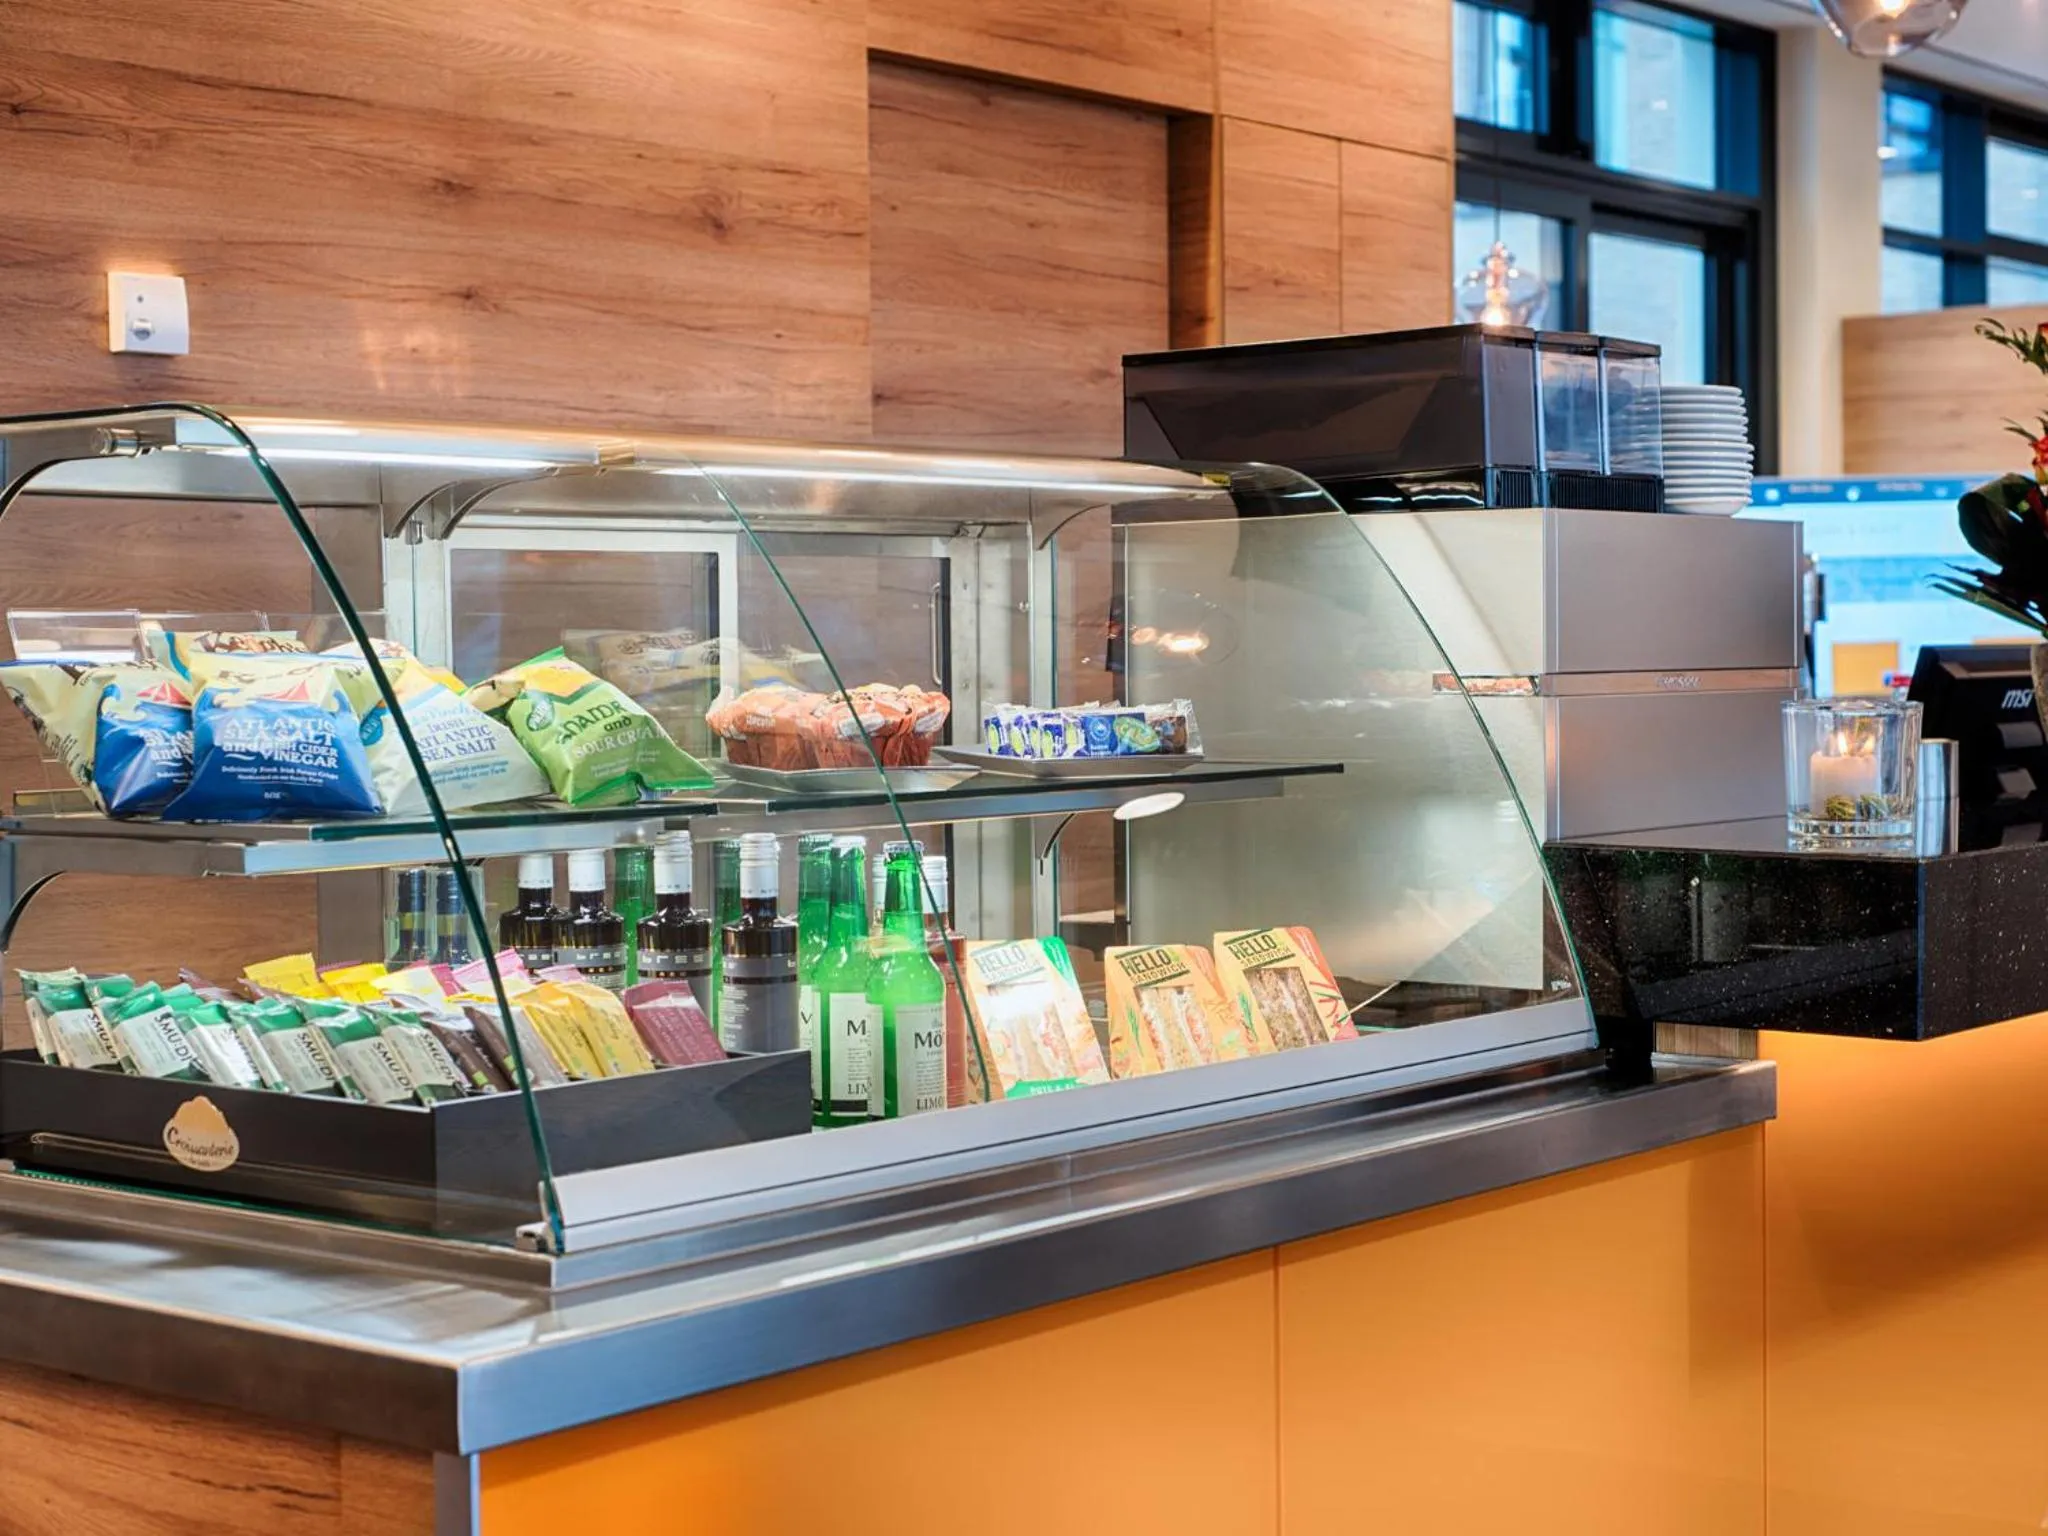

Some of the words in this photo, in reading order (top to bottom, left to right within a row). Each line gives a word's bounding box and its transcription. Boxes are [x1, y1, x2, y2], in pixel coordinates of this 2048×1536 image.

[222, 718, 336, 735] ATLANTIC
[603, 715, 632, 732] and
[223, 727, 271, 741] SEA
[275, 727, 336, 746] SALT
[222, 739, 259, 753] and
[298, 742, 339, 758] CIDER
[456, 737, 498, 757] SALT
[260, 747, 339, 768] VINEGAR
[1227, 934, 1277, 960] HELLO
[973, 944, 1025, 973] HELLO
[1118, 948, 1172, 977] HELLO
